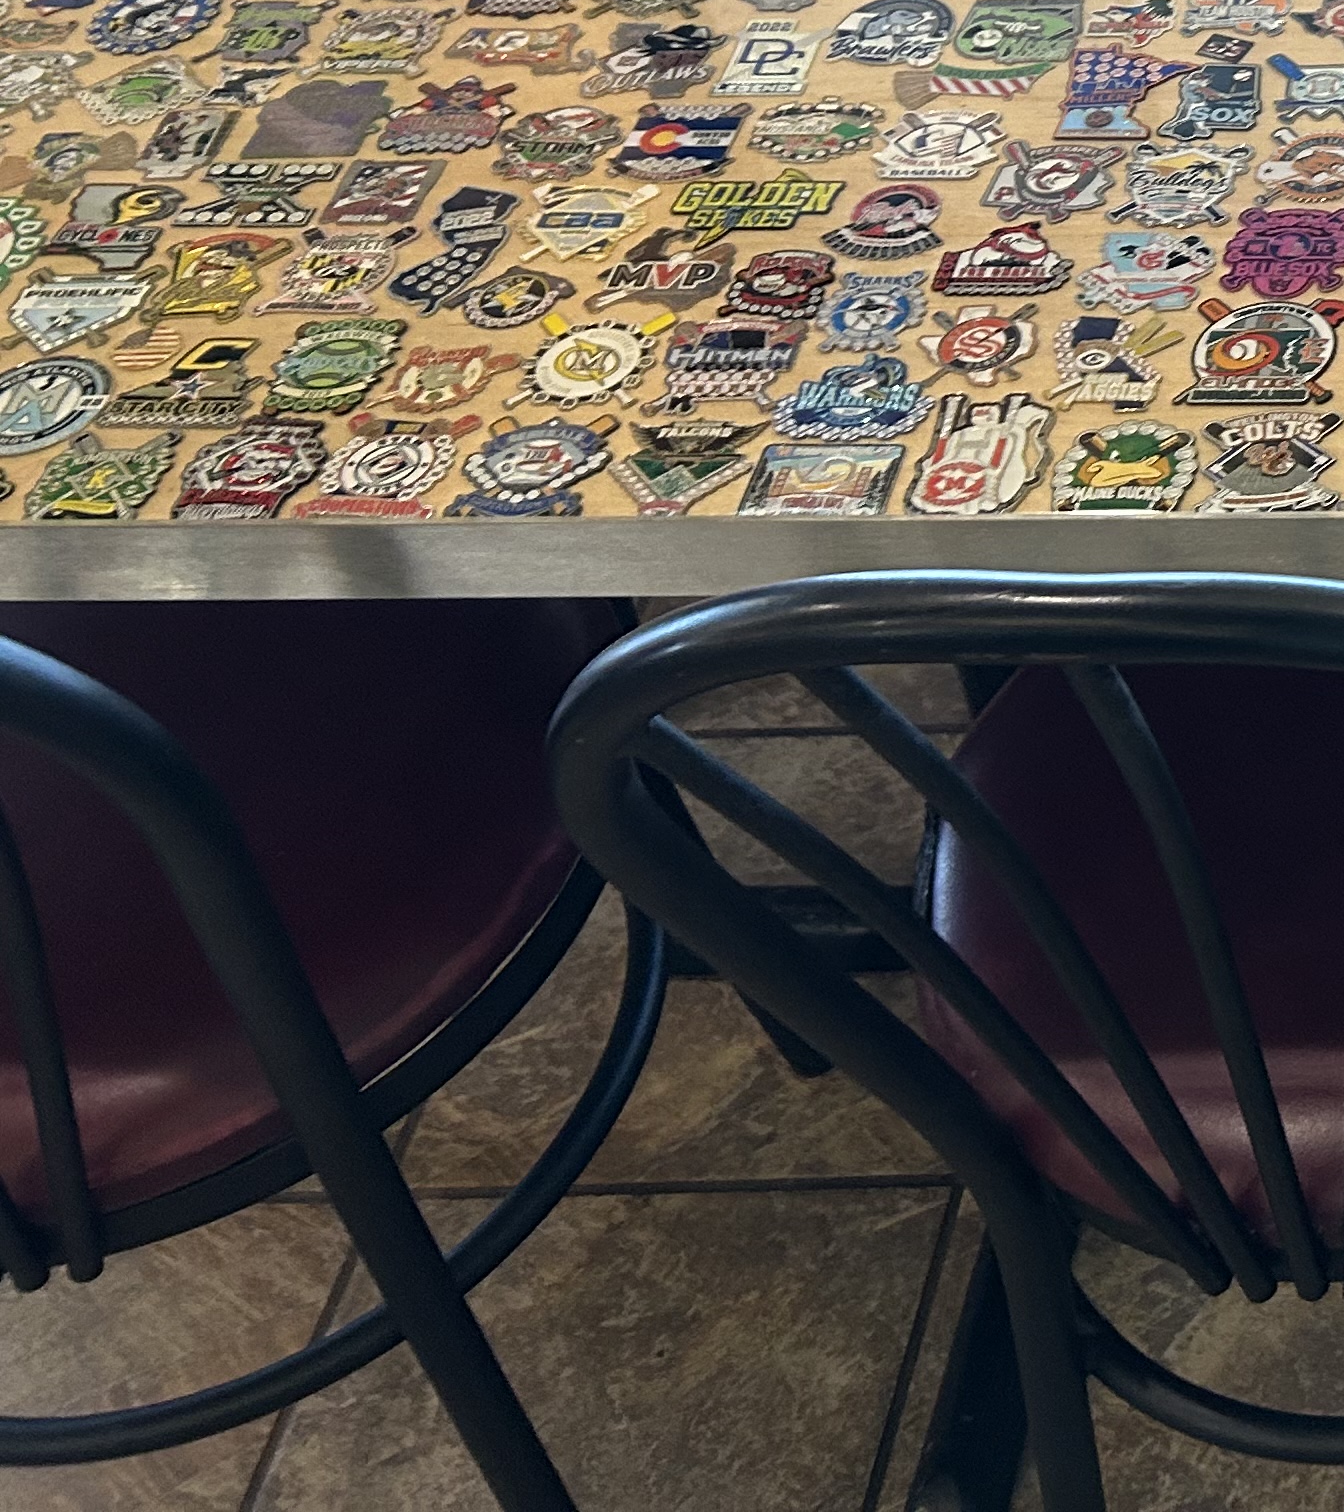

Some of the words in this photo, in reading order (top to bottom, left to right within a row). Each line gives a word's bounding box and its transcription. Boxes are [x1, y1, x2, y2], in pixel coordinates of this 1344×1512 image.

[747, 22, 792, 32] 2022
[830, 39, 937, 62] Brawlers
[1190, 107, 1253, 123] SOX
[513, 141, 595, 156] STORM
[1128, 170, 1229, 190] Bulldogs
[672, 183, 845, 212] GOLDEN
[607, 264, 719, 287] MVP
[852, 275, 917, 288] SHARKS
[668, 347, 793, 364] HITMEN
[1081, 382, 1157, 402] AGGIES
[112, 401, 174, 415] STAR
[176, 400, 241, 416] CITY
[658, 426, 733, 438] FALCONS
[1221, 422, 1325, 443] COLTS
